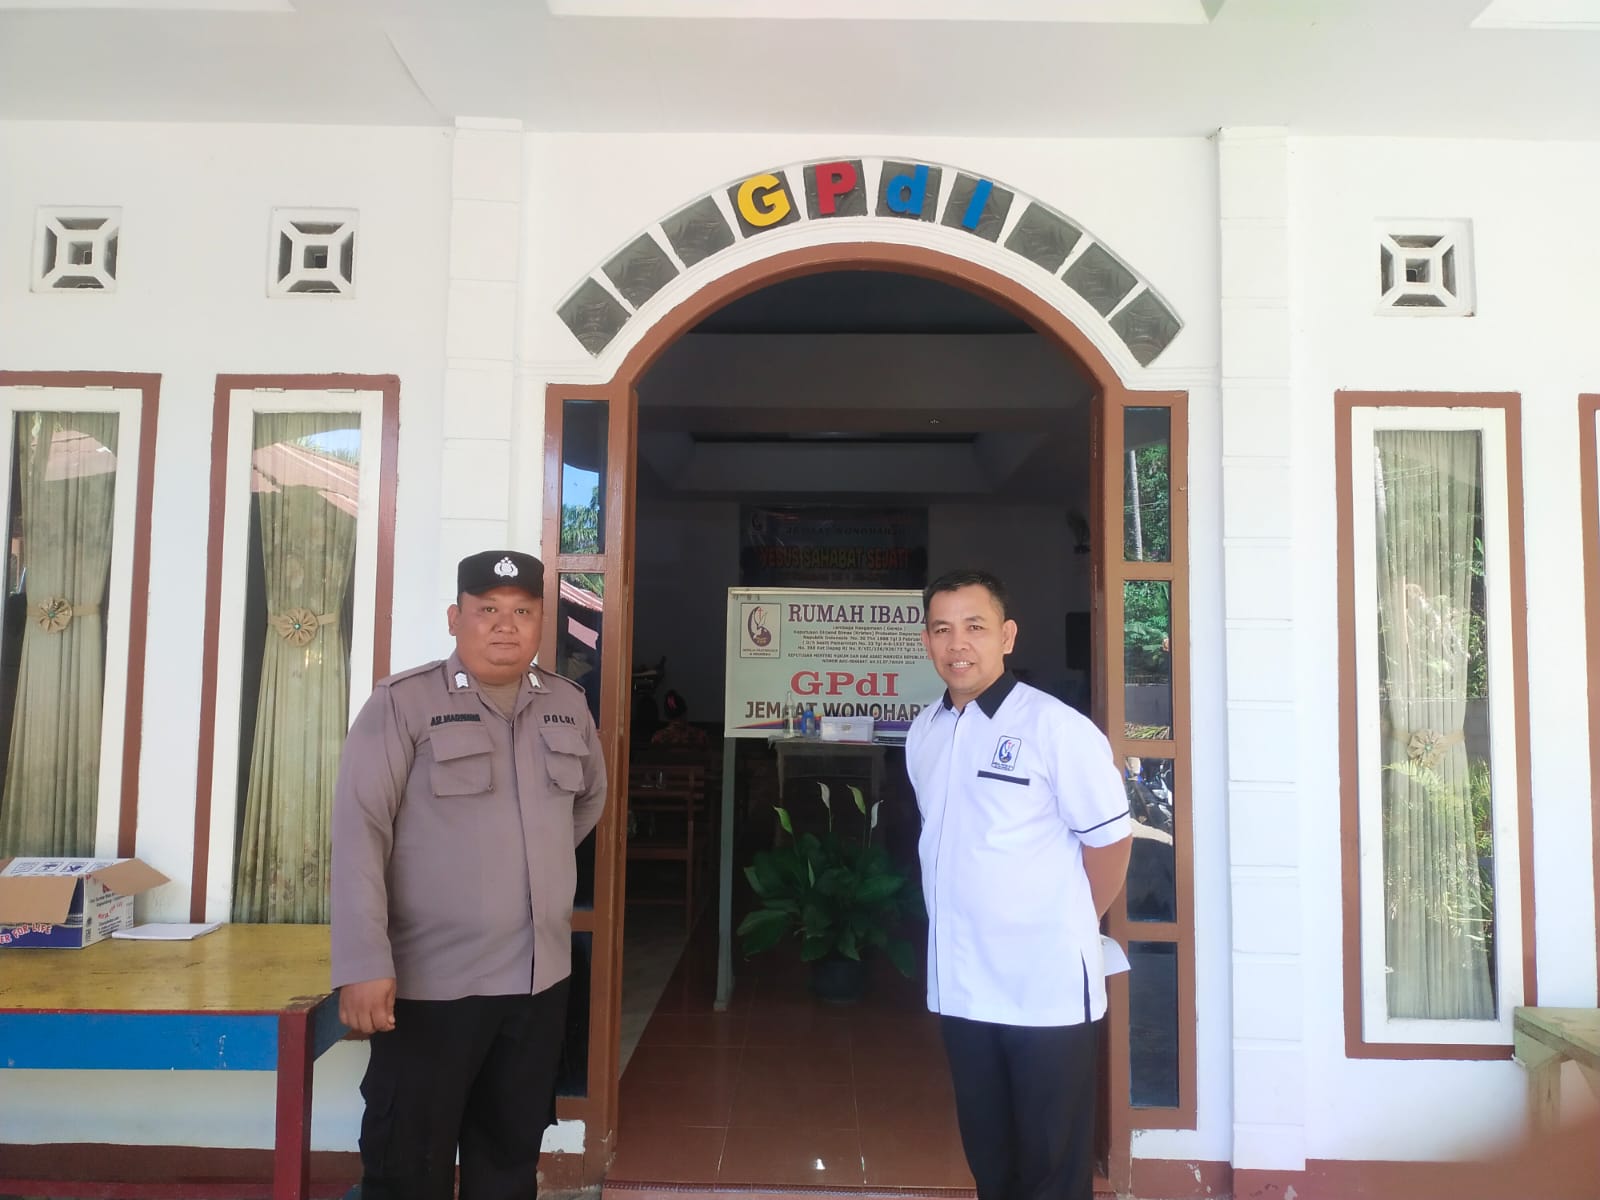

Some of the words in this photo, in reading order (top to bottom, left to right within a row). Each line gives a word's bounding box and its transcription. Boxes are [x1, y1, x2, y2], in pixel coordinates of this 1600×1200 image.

[801, 547, 864, 569] SAHABAT
[788, 603, 865, 623] RUMAH
[870, 605, 928, 625] IBAD
[790, 670, 899, 697] GPdI
[822, 702, 930, 721] WONOHAR
[11, 923, 30, 939] FOR
[31, 922, 53, 935] LIFE
